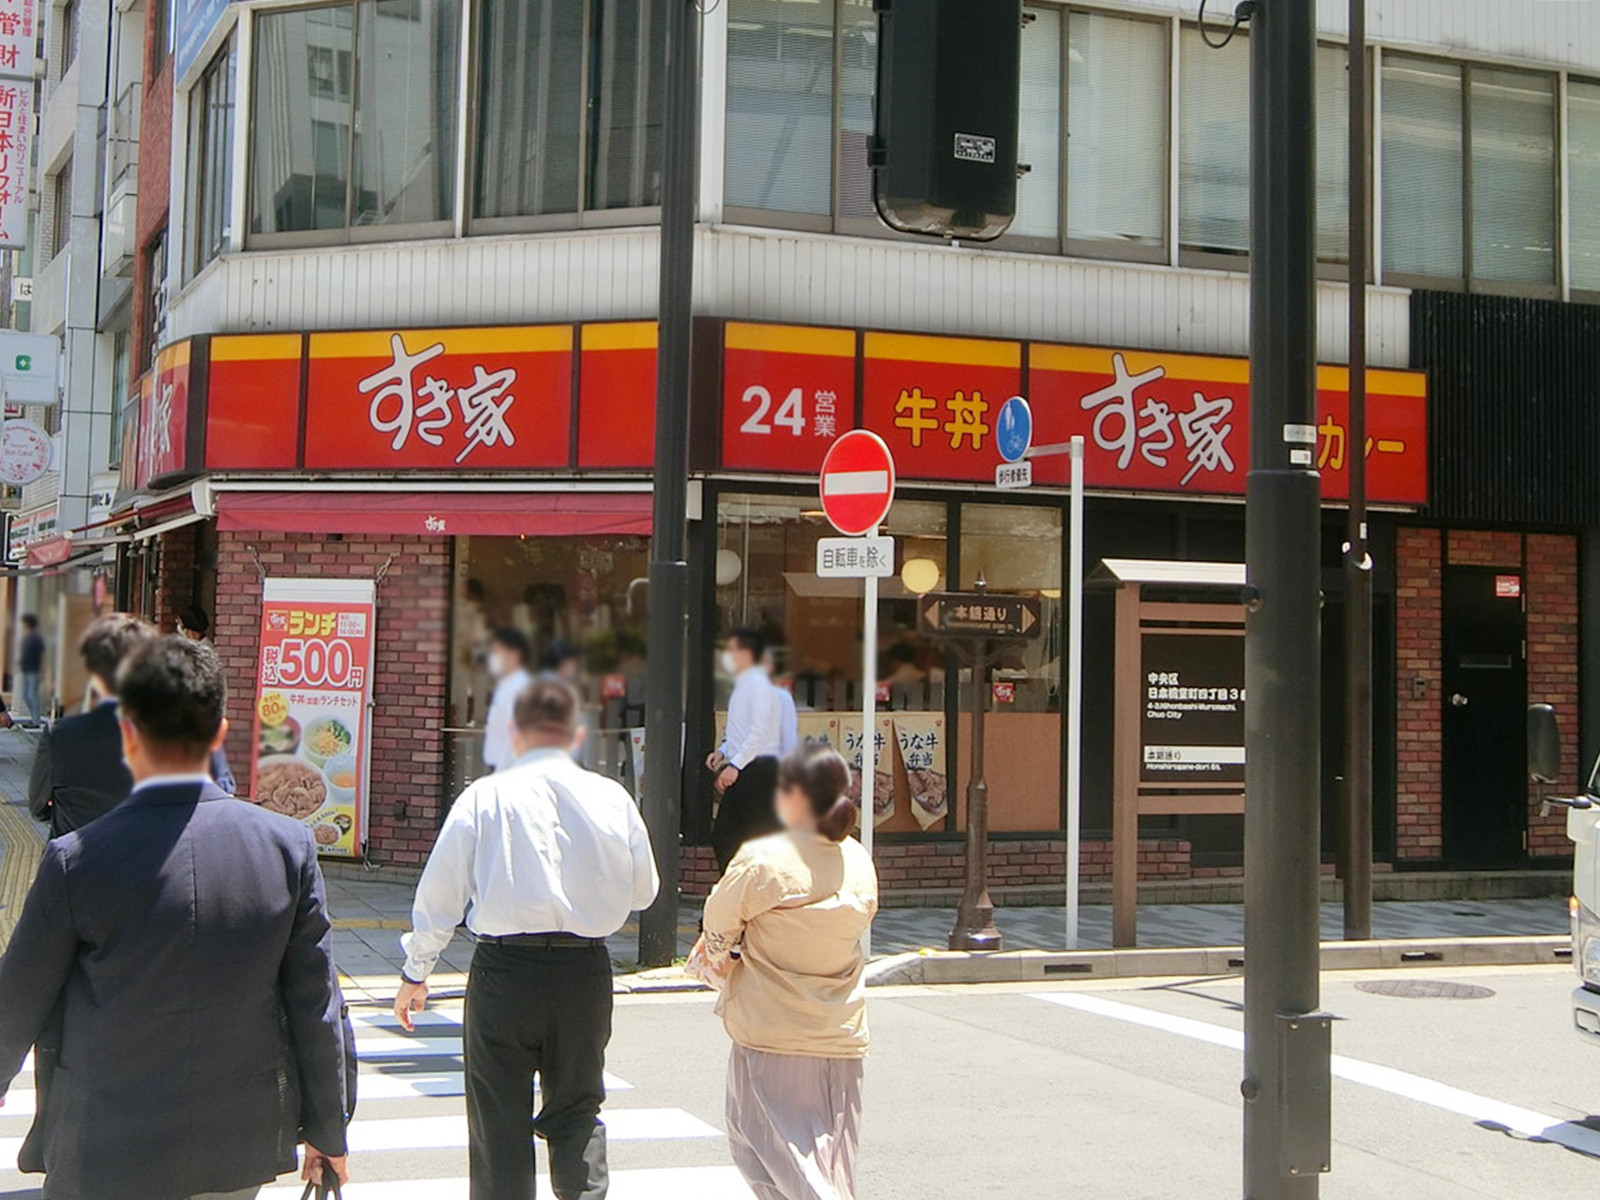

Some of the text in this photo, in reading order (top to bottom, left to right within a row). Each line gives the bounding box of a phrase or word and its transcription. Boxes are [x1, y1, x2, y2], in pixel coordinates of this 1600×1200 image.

[0, 0, 20, 68] 管財
[358, 333, 517, 464] すき家
[740, 385, 806, 436] 24
[814, 390, 837, 438] 営業
[894, 387, 989, 449] 牛丼
[1080, 352, 1235, 486] すき家
[1317, 413, 1405, 471] カー
[823, 546, 887, 569] 自転車を除く
[289, 610, 337, 636] ランチ
[955, 604, 1007, 621] 本銀通り
[263, 647, 279, 683] 税込
[1147, 672, 1179, 685] 中央区
[1166, 711, 1182, 719] City
[900, 732, 939, 750] うな牛
[909, 751, 934, 767] 弁当
